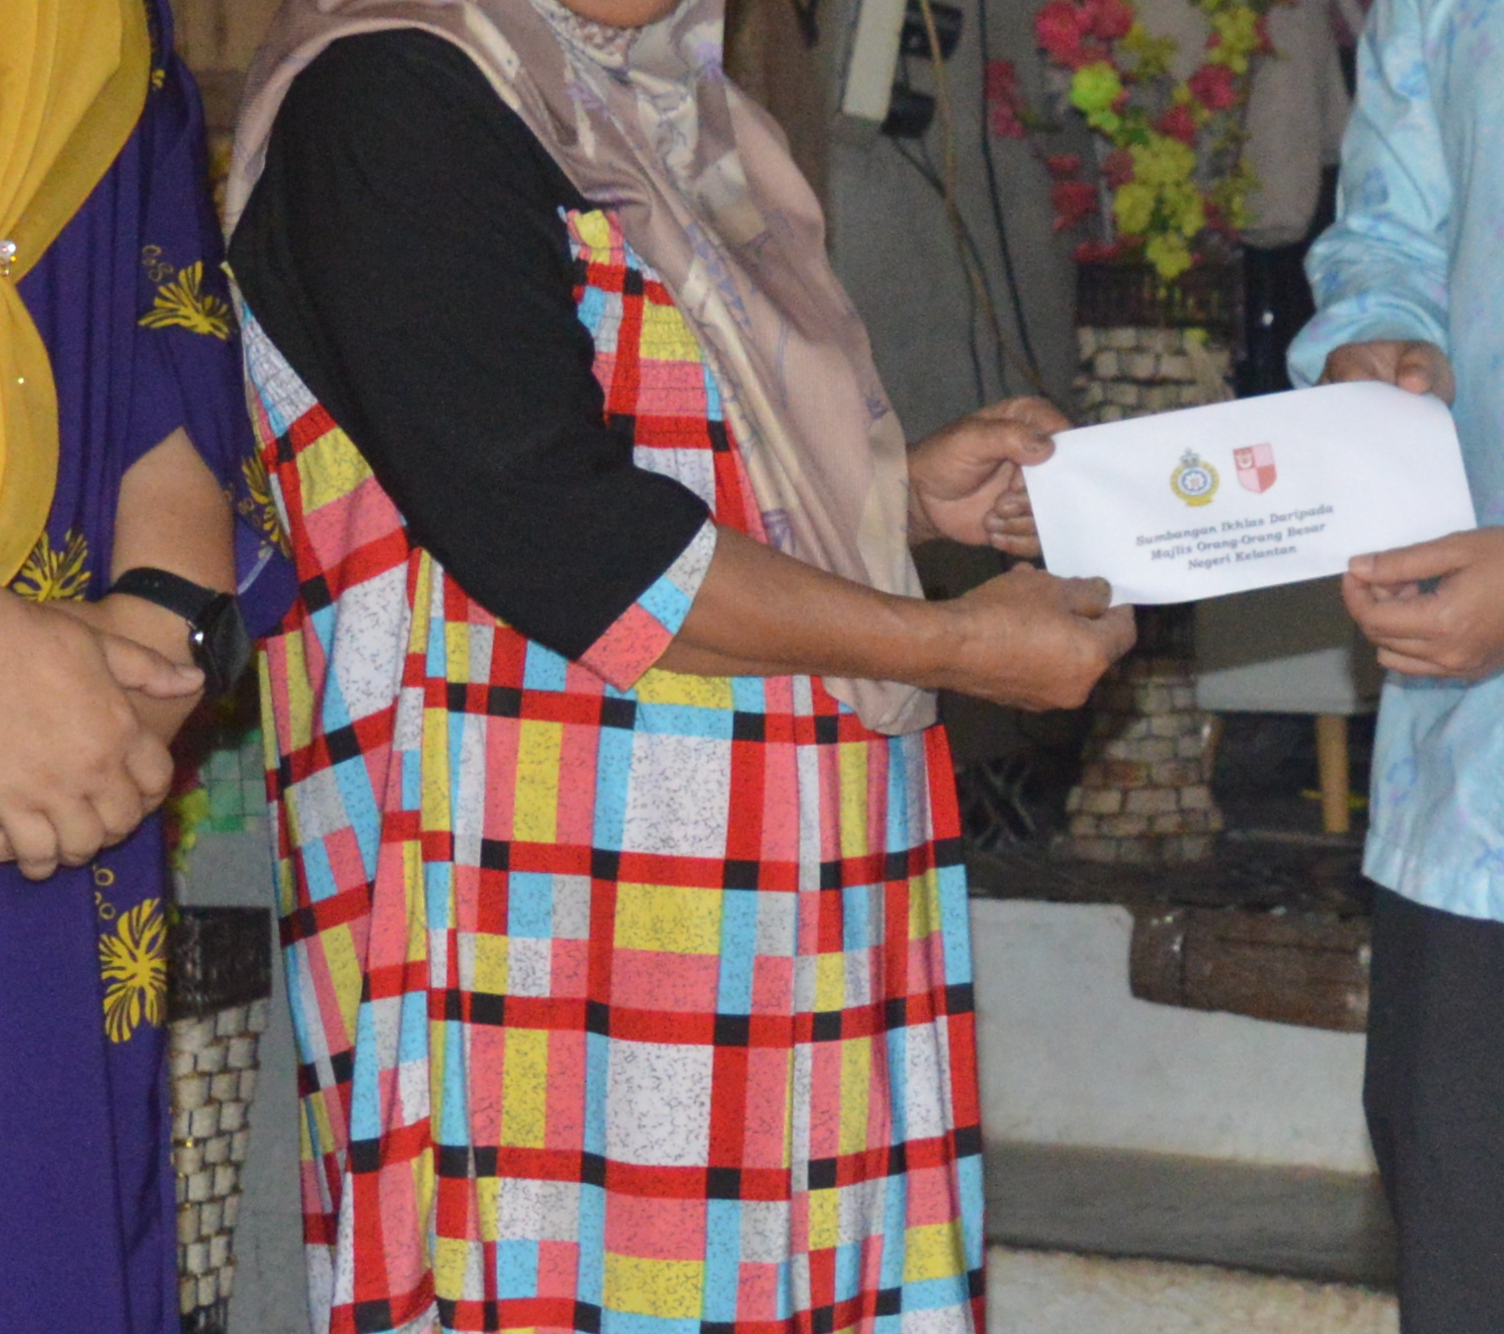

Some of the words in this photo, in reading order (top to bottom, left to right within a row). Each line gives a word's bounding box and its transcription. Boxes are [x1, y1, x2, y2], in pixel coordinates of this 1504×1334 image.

[1135, 525, 1217, 547] Sumbangan
[1221, 517, 1265, 533] Ikhlas
[1269, 504, 1334, 525] Daripada
[1151, 545, 1192, 561] Majlis
[1287, 522, 1326, 538] Besar
[1188, 554, 1231, 570] Negeri
[1235, 544, 1297, 562] Kelantan
